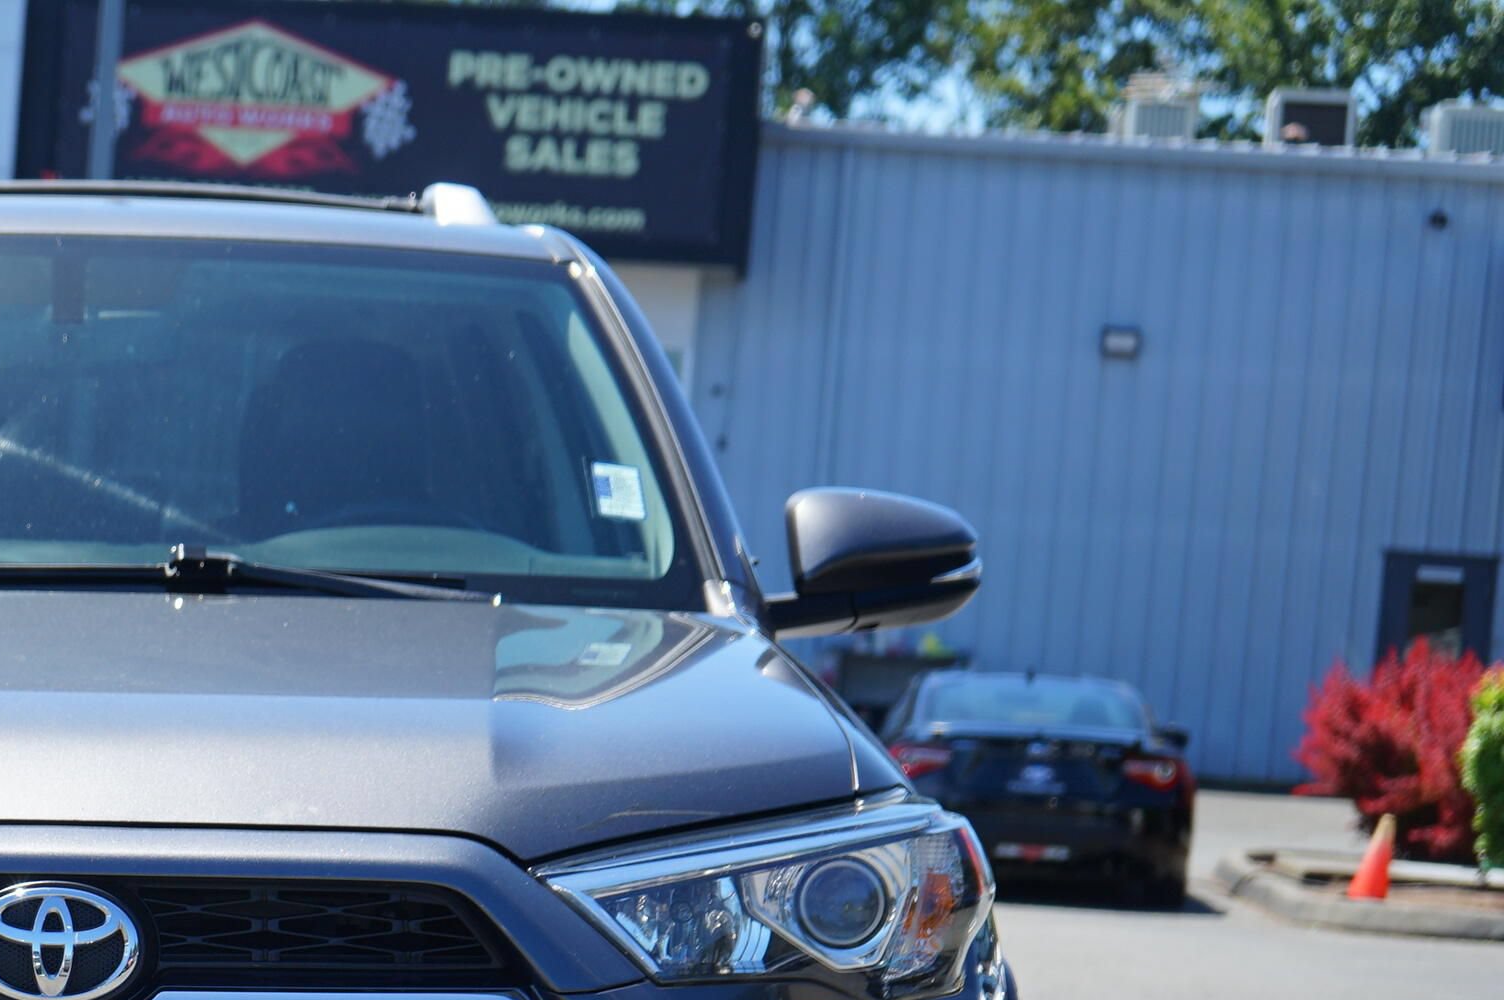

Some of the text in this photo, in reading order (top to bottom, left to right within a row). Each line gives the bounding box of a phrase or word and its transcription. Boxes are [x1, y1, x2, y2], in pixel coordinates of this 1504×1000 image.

[161, 40, 344, 105] WEST COAST
[448, 51, 710, 99] PRE-OWNED
[486, 94, 667, 139] VEHICLE
[504, 134, 640, 178] SALES
[489, 200, 647, 231] oworks.com
